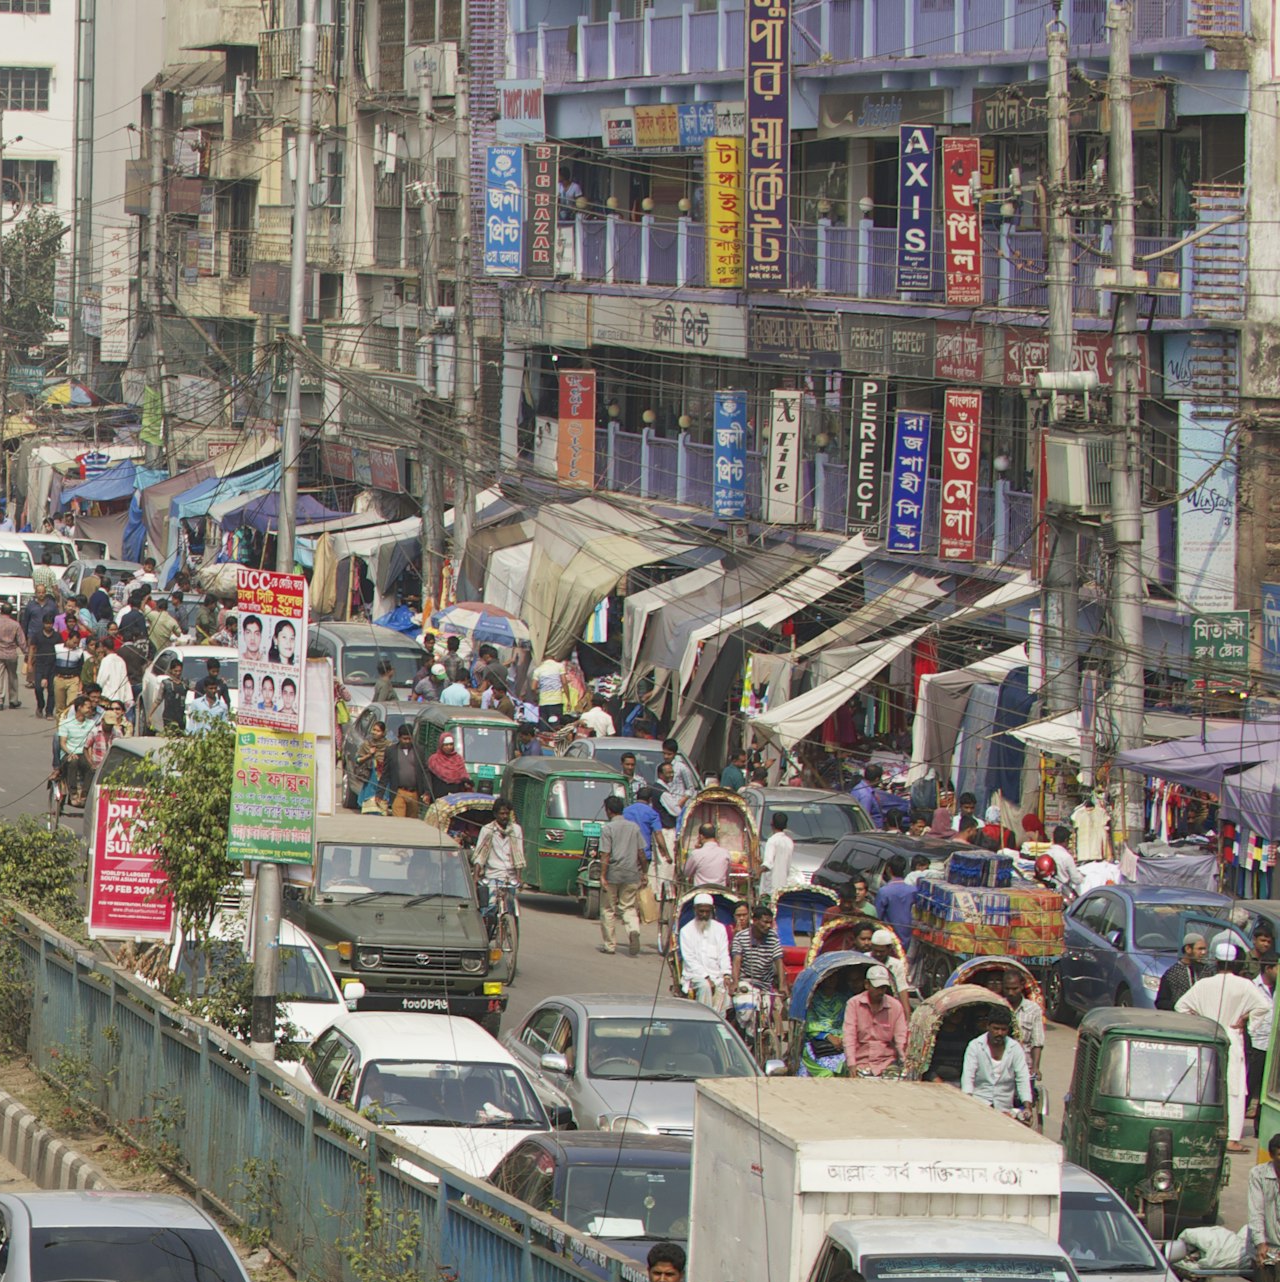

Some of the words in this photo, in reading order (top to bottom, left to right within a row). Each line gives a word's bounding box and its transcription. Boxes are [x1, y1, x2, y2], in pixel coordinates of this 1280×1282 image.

[492, 148, 517, 156] Johny
[535, 147, 551, 188] BIG
[487, 180, 520, 211] জনী
[715, 142, 740, 239] টাঙ্গাইল
[750, 117, 784, 263] মার্কেট
[904, 129, 930, 252] AXIS
[487, 217, 520, 245] প্রিন্ট
[533, 196, 550, 263] BAZAR
[651, 304, 677, 349] জনী
[680, 307, 710, 349] প্রিন্ট
[850, 326, 884, 350] PERFECT
[892, 330, 927, 353] PERFECT
[776, 398, 797, 424] X
[948, 395, 978, 409] বাংলার
[717, 422, 744, 448] জনী
[774, 432, 796, 493] File
[856, 381, 878, 520] PERFECT
[898, 415, 924, 495] রাজশাহী
[716, 453, 744, 484] প্রিন্ট
[943, 478, 973, 536] মেলা
[848, 526, 878, 535] TEXTILE
[238, 570, 271, 590] UCC
[237, 589, 255, 603] ঢাকা
[256, 589, 274, 604] সিটি
[276, 593, 303, 608] কলেজ
[261, 602, 273, 614] ১ম
[277, 604, 293, 617] ২য়
[1192, 617, 1245, 641] মিতালী
[266, 771, 311, 794] ফাল্গুন
[100, 869, 125, 878] WORLD'S
[126, 871, 151, 879] LARGEST
[99, 884, 114, 893] 7-9
[115, 885, 133, 894] FEB
[134, 886, 155, 895] 2014
[1132, 1041, 1165, 1050] VOLVO
